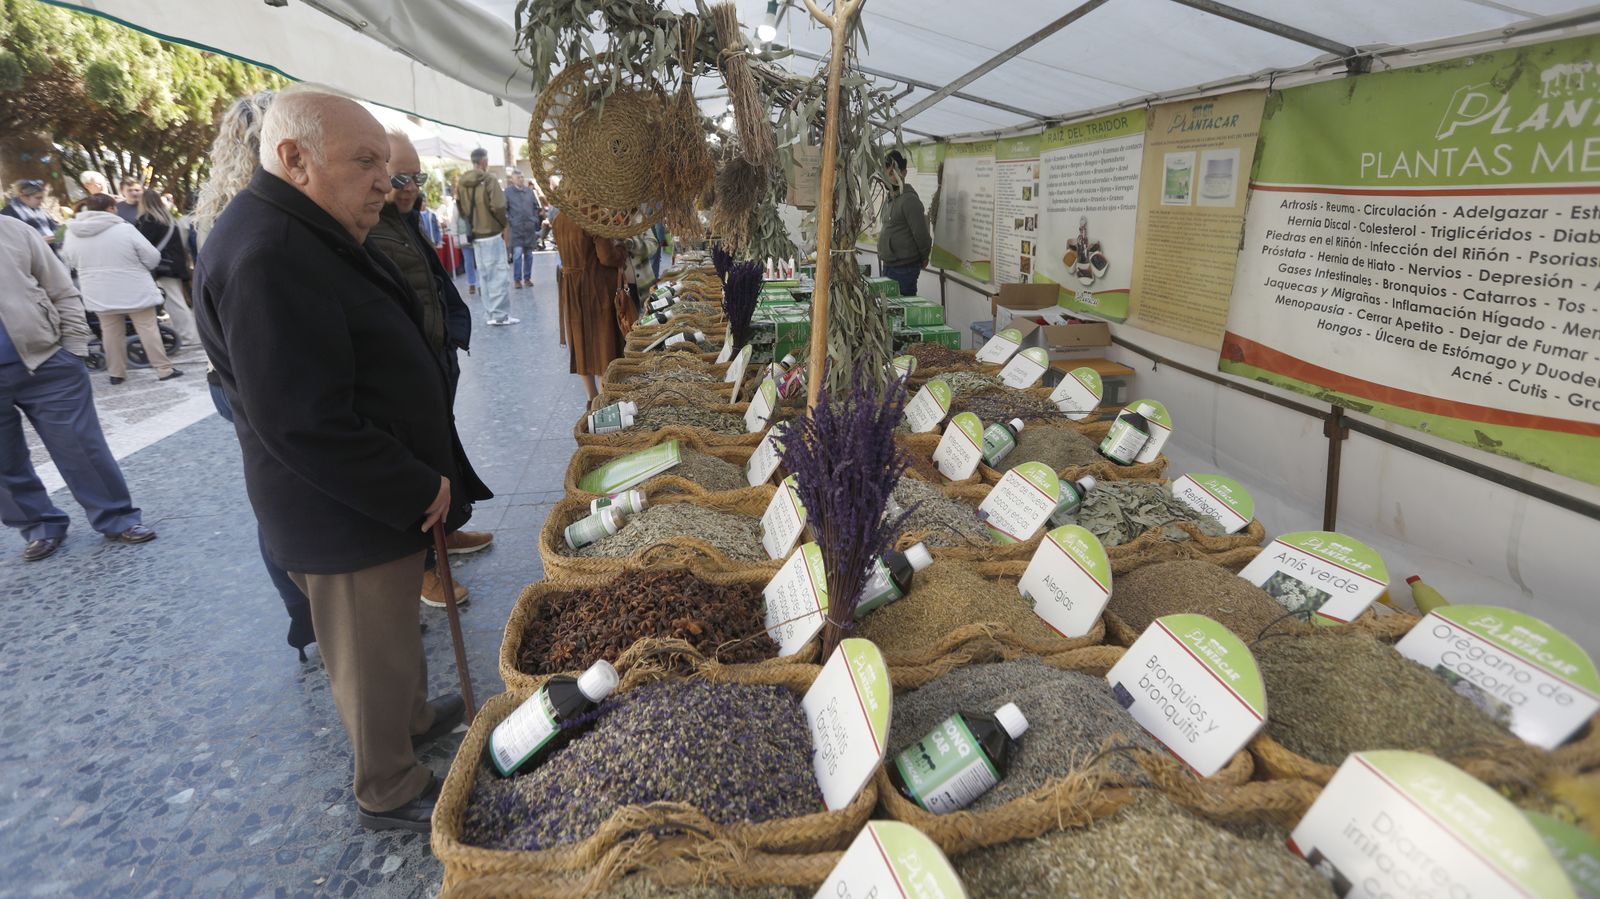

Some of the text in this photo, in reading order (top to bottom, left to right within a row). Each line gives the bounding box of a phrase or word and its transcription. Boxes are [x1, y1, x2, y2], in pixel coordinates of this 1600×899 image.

[1068, 127, 1083, 140] DEL
[1087, 117, 1129, 135] TRAIDOR
[1168, 112, 1239, 134] PLANTACAR
[1360, 143, 1513, 179] PLANTAS
[1280, 199, 1318, 211] Artrosis
[1326, 201, 1355, 214] Reuma
[1364, 204, 1436, 217] Circulación
[1453, 205, 1549, 222] Adelgazar
[1287, 216, 1322, 228] Hernia
[1324, 218, 1351, 231] Discal
[1359, 221, 1417, 237] Colesterol
[1431, 225, 1533, 242] Triglicéridos
[1262, 245, 1573, 289] Próstata Hernia de Hiato Nervios Depresión
[1266, 229, 1306, 243] Piedras
[1309, 235, 1323, 245] en
[1325, 236, 1334, 246] el
[1336, 236, 1362, 250] Riñón
[1370, 241, 1428, 256] Infección
[1433, 246, 1457, 259] del
[1462, 247, 1510, 262] Riñón
[1264, 277, 1318, 294] Jaquecas
[1321, 287, 1329, 298] y
[1331, 287, 1381, 306] Migrañas
[1392, 298, 1476, 320] Inflamación
[1482, 310, 1545, 330] Hígado
[1278, 263, 1586, 314] Gases Intestinales Bronquios Catarros Tos
[1275, 295, 1589, 362] Menopausia Cerrar Apetito Dejar de Fumar
[1317, 318, 1362, 337] Hongos
[1375, 327, 1415, 348] Úlcera
[1418, 340, 1438, 352] de
[1442, 343, 1517, 370] Estómago
[1521, 361, 1532, 375] y
[1451, 366, 1493, 385] Acné
[1508, 379, 1548, 400] Cutis
[1273, 552, 1359, 594] Anís verde
[1300, 536, 1372, 571] PLANTACAR
[1184, 628, 1241, 682] PLANTACAR
[1432, 624, 1574, 706] Orégano de
[1468, 615, 1579, 675] PLANTACAR
[1146, 654, 1208, 722] Bronquios
[1441, 650, 1528, 706] Cazorla
[827, 696, 848, 755] Sinusitis
[1138, 673, 1200, 744] bronquitis
[816, 708, 838, 776] faringitis
[932, 731, 950, 757] CAR
